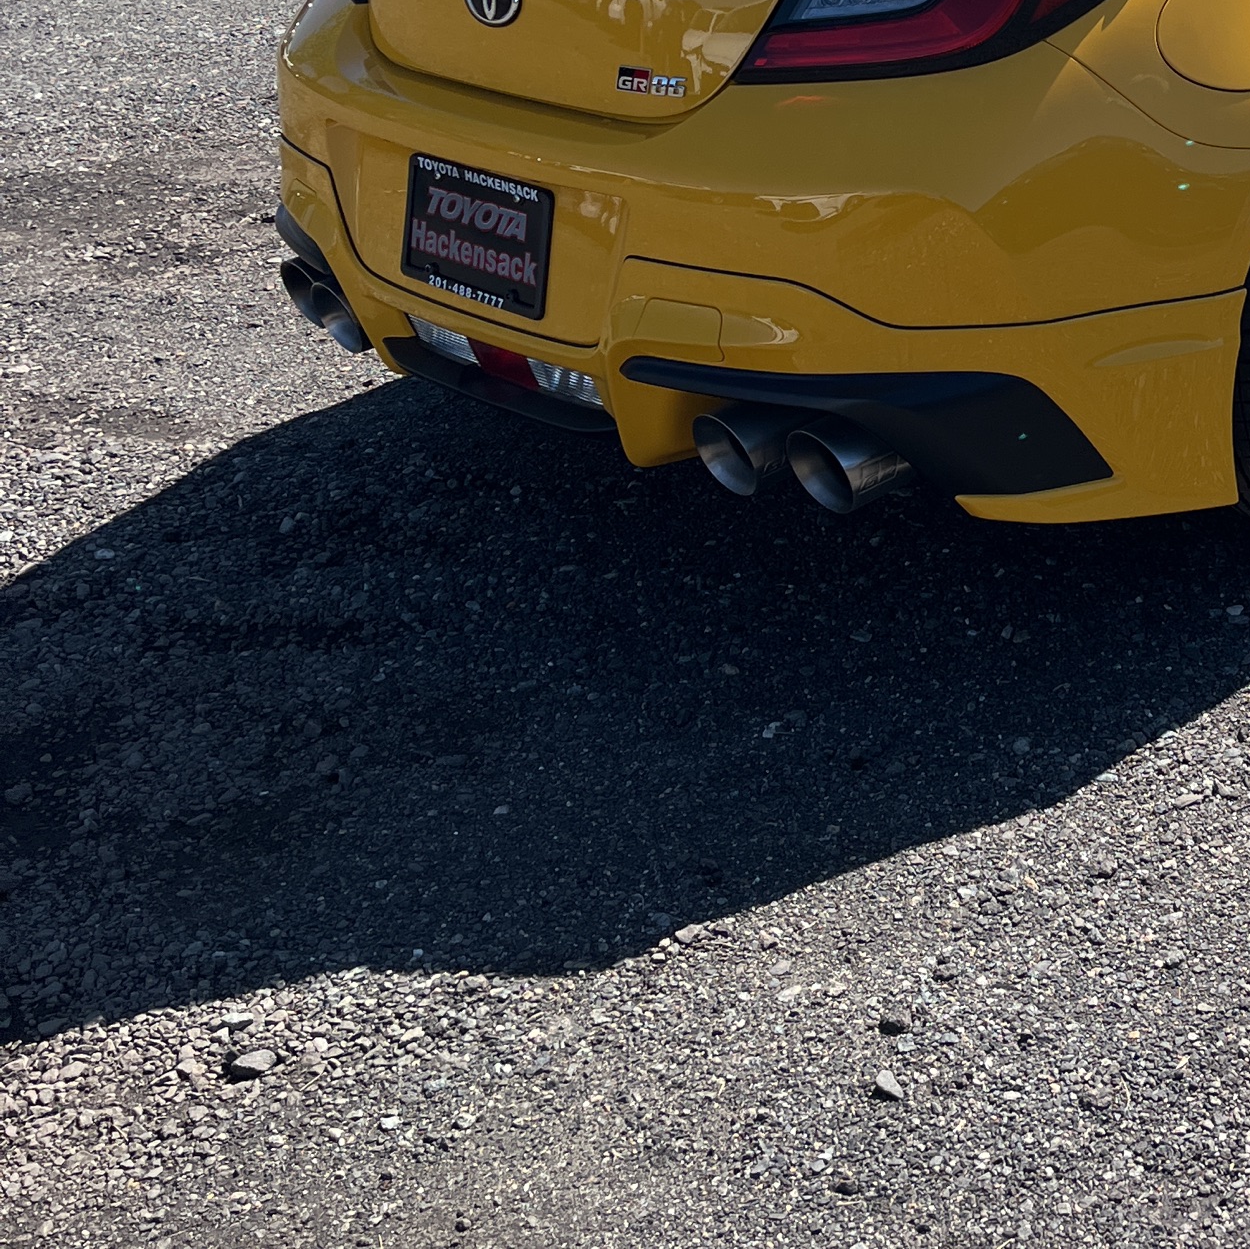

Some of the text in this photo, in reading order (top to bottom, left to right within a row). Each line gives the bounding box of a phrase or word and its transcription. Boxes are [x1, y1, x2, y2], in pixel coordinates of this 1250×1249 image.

[417, 156, 539, 202] TOYOTA HACKENSACK
[426, 186, 528, 243] TOYOTA
[410, 217, 539, 287] Hackensack
